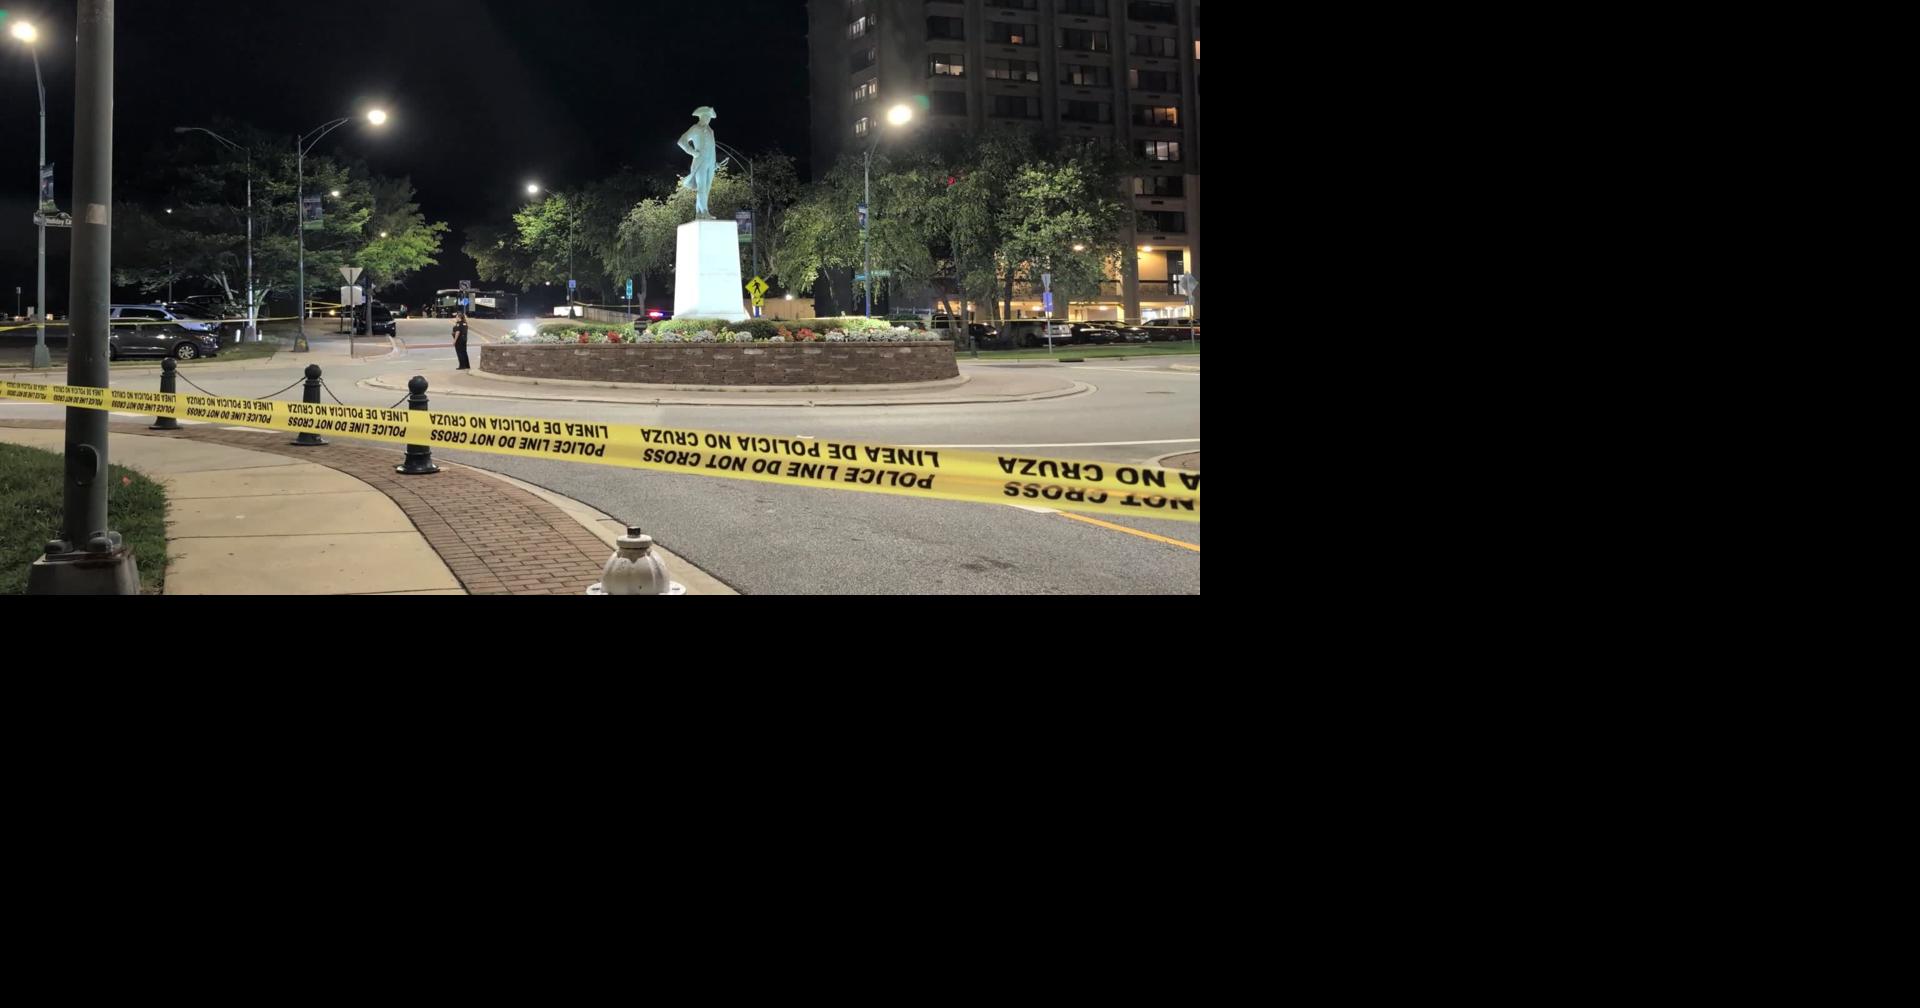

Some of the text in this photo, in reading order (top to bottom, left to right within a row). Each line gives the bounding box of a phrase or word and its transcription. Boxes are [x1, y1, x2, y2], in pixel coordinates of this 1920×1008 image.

[111, 390, 126, 399] CRUZA
[127, 391, 133, 399] NO
[134, 392, 153, 401] POLICIA
[161, 394, 176, 403] LINEA
[111, 400, 126, 408] CROSS
[136, 402, 143, 410] DO
[144, 403, 156, 411] LINE
[157, 405, 175, 414] POLICE
[186, 396, 273, 411] LINEA DE POLICIA NO CRUZA
[186, 407, 272, 424] POLICE LINE DO NOT CROSS
[287, 403, 408, 422] LINEA DE POLICIA NO CRUZA
[288, 417, 406, 437] POLICE LINE DO NOT CROSS
[429, 413, 608, 438] LINEA DE POLICIA NO CRUZA
[430, 430, 606, 457] POLICE LINE DO NOT CROSS
[640, 429, 939, 468] LINEA DE POLICIA NO CRUZA
[643, 448, 935, 490] POLICE LINE DO NOT CROSS
[997, 456, 1104, 482] CRUZA
[1116, 467, 1166, 488] NO
[1004, 482, 1108, 504] CROSS
